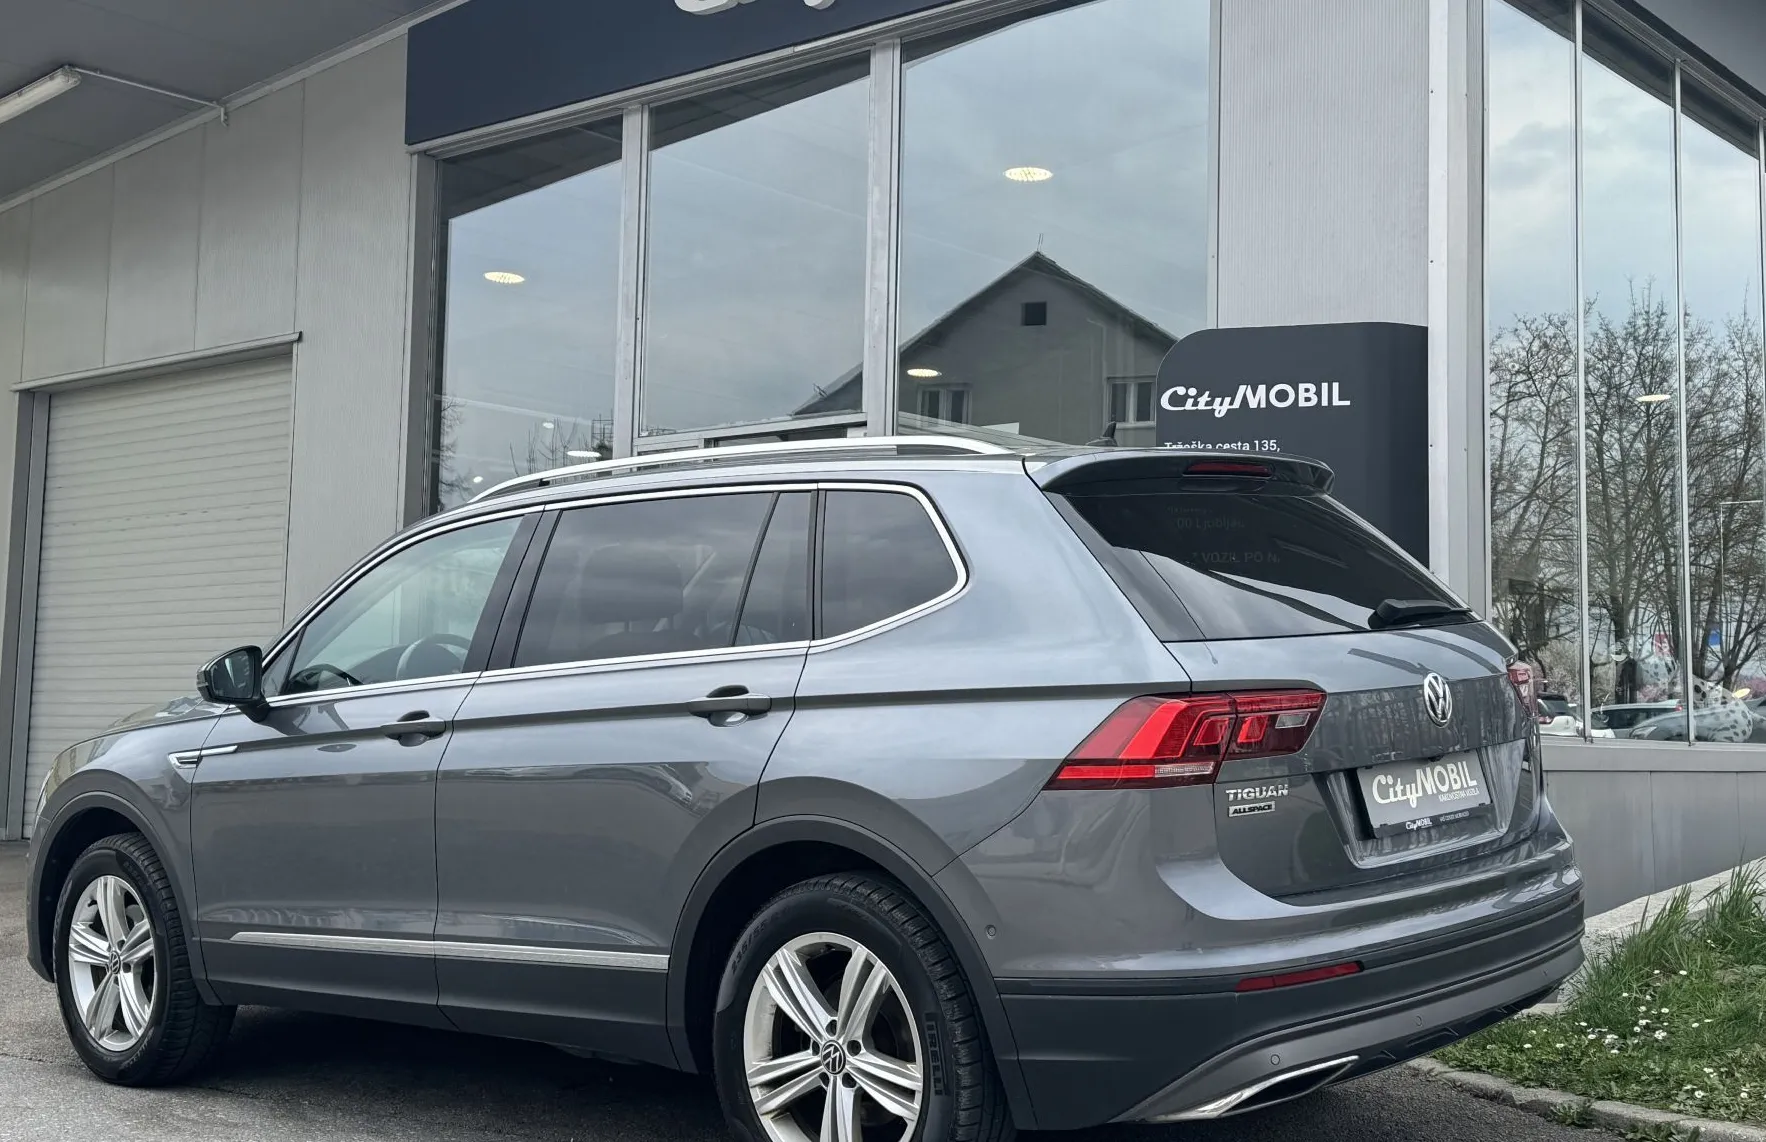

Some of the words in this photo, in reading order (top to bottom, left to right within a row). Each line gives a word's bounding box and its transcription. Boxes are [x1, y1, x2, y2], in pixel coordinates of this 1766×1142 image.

[1160, 382, 1350, 417] CityMOBIL
[1215, 441, 1250, 451] cesta
[1254, 439, 1280, 452] 135,
[1225, 783, 1289, 802] TIGUAN
[1372, 760, 1478, 808] CityMOBIL
[1232, 804, 1274, 815] ALLSPACE
